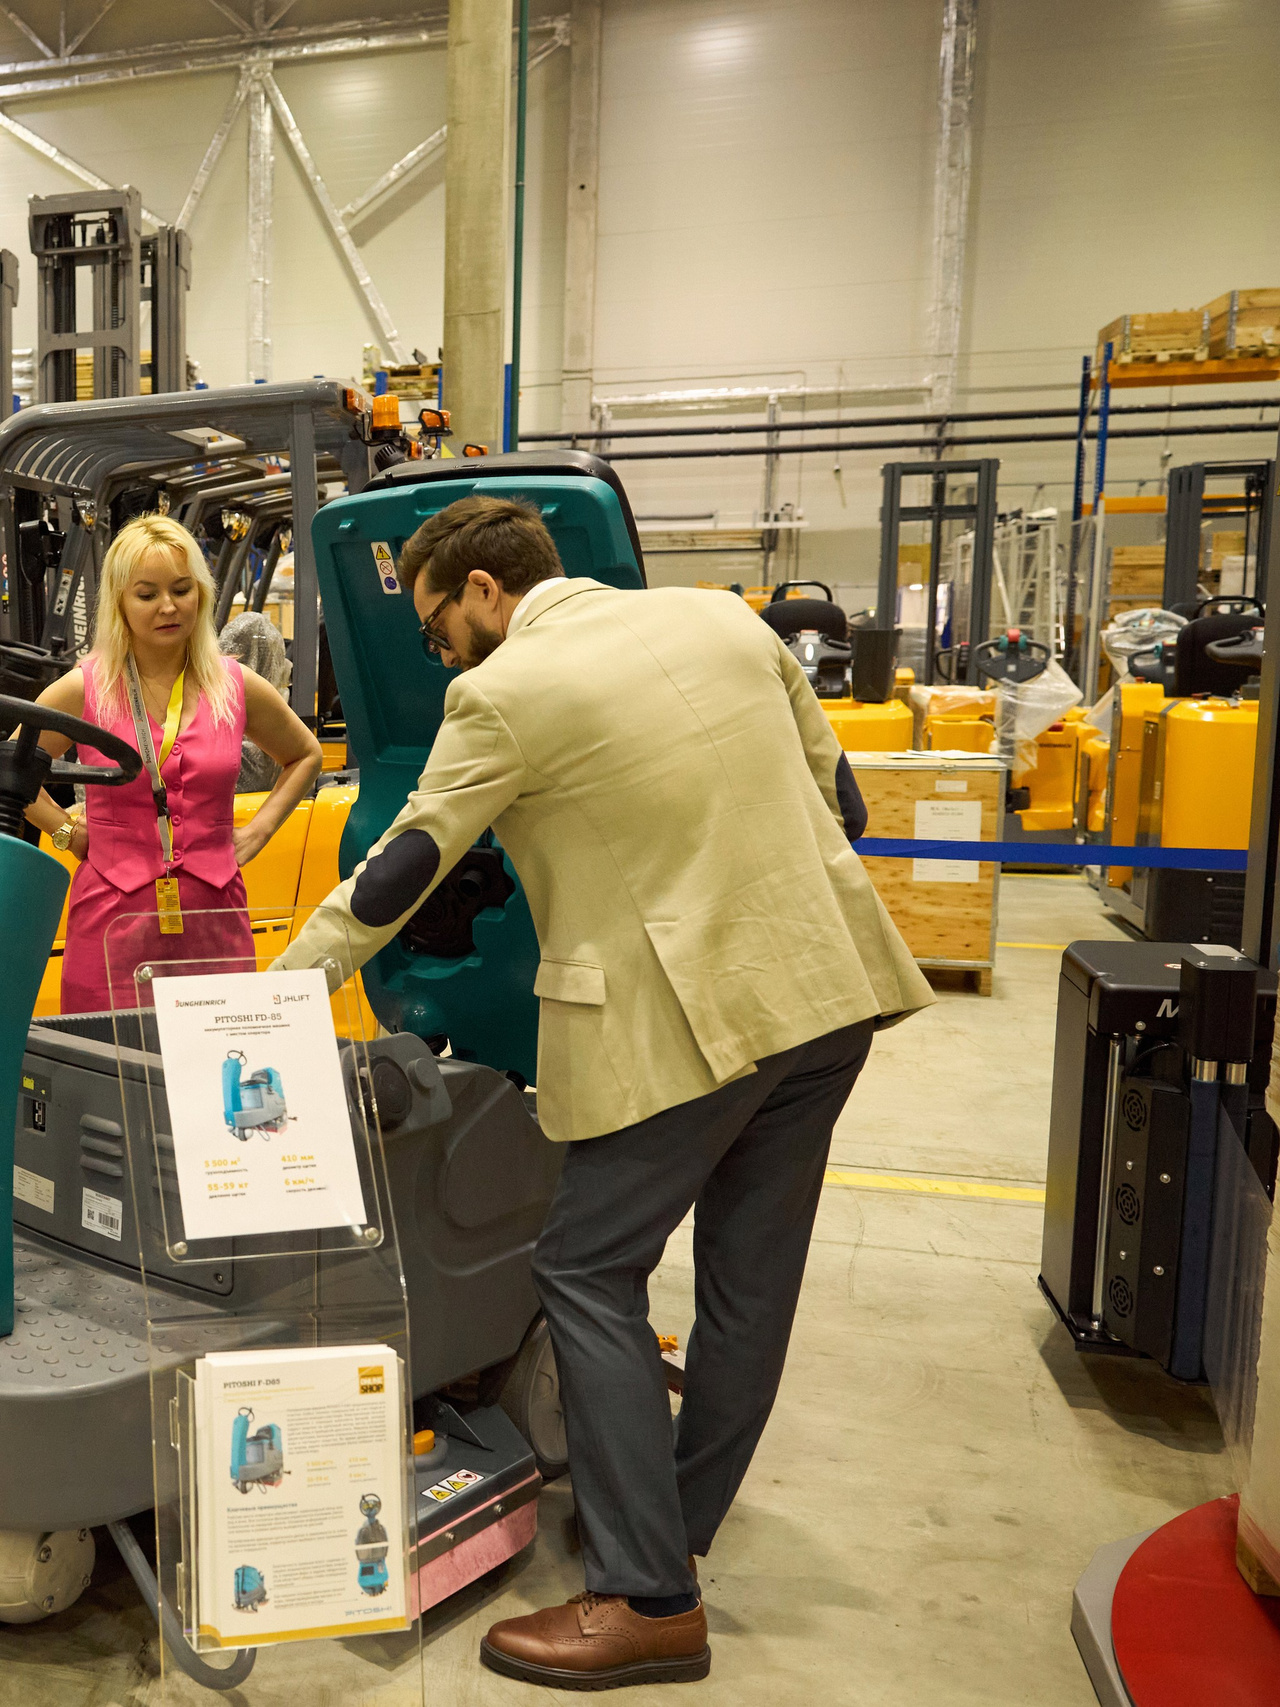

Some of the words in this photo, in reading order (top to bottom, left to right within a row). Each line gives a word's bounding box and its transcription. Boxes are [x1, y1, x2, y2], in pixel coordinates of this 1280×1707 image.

[283, 994, 310, 1002] JHLIFT
[175, 999, 226, 1008] JUNGHEINRICH
[214, 1014, 253, 1024] PITOSHI
[256, 1012, 282, 1022] FD-85
[224, 1380, 256, 1389] PITOSHI
